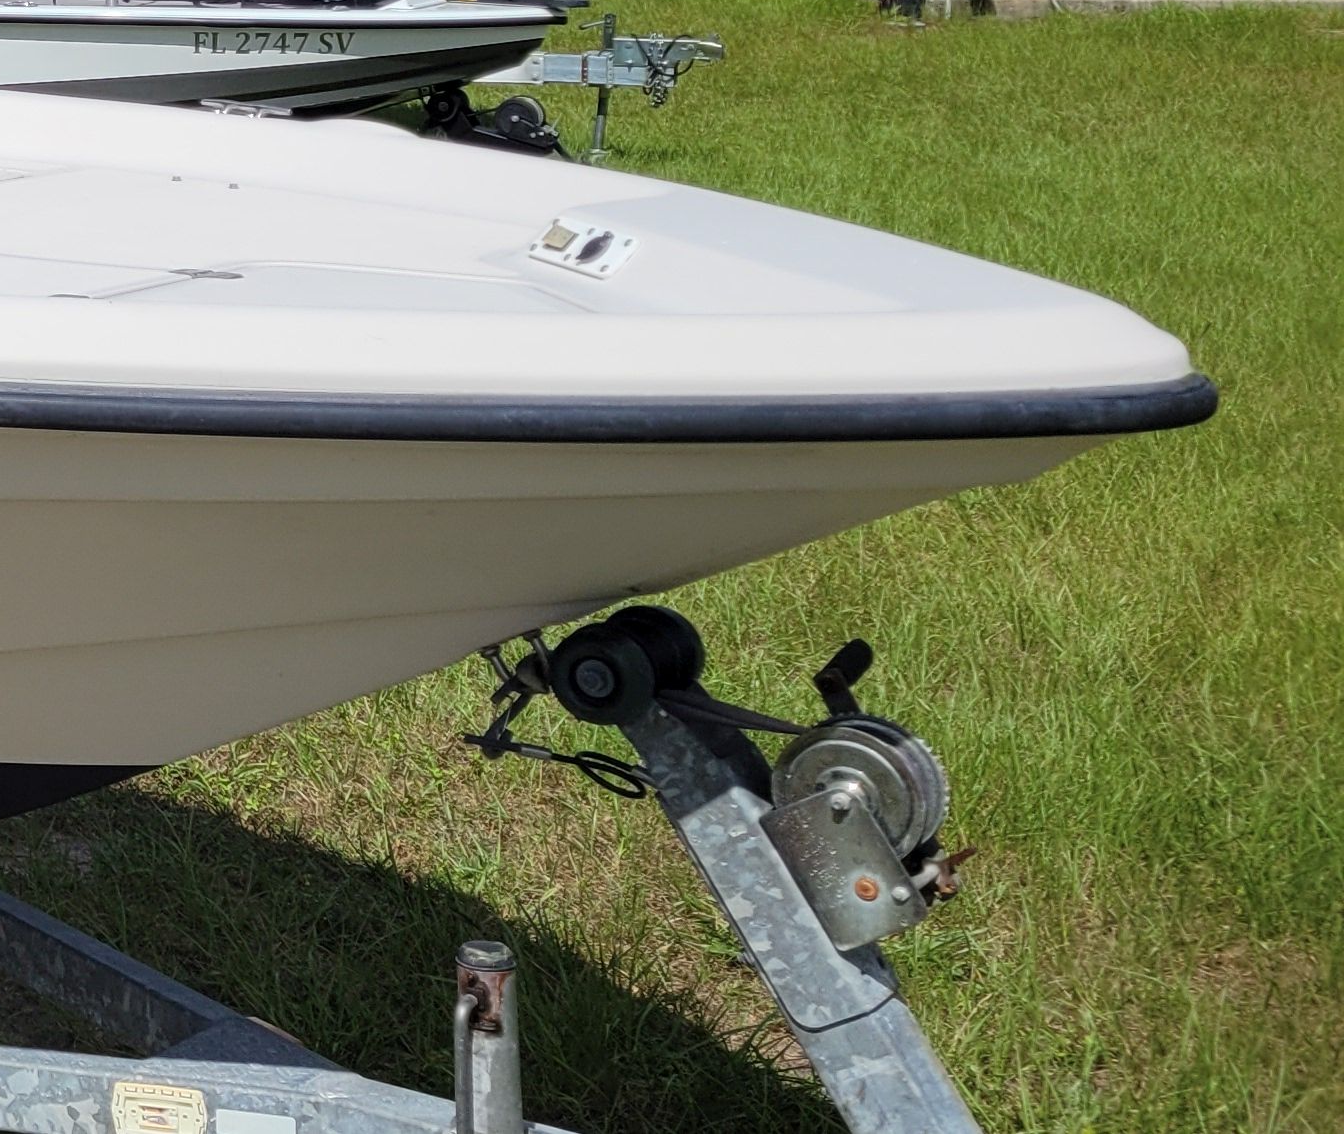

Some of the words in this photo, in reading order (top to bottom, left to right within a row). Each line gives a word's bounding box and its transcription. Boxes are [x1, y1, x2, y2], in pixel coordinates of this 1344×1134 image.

[192, 31, 226, 54] FL
[235, 32, 310, 54] 2747
[318, 32, 356, 54] SV
